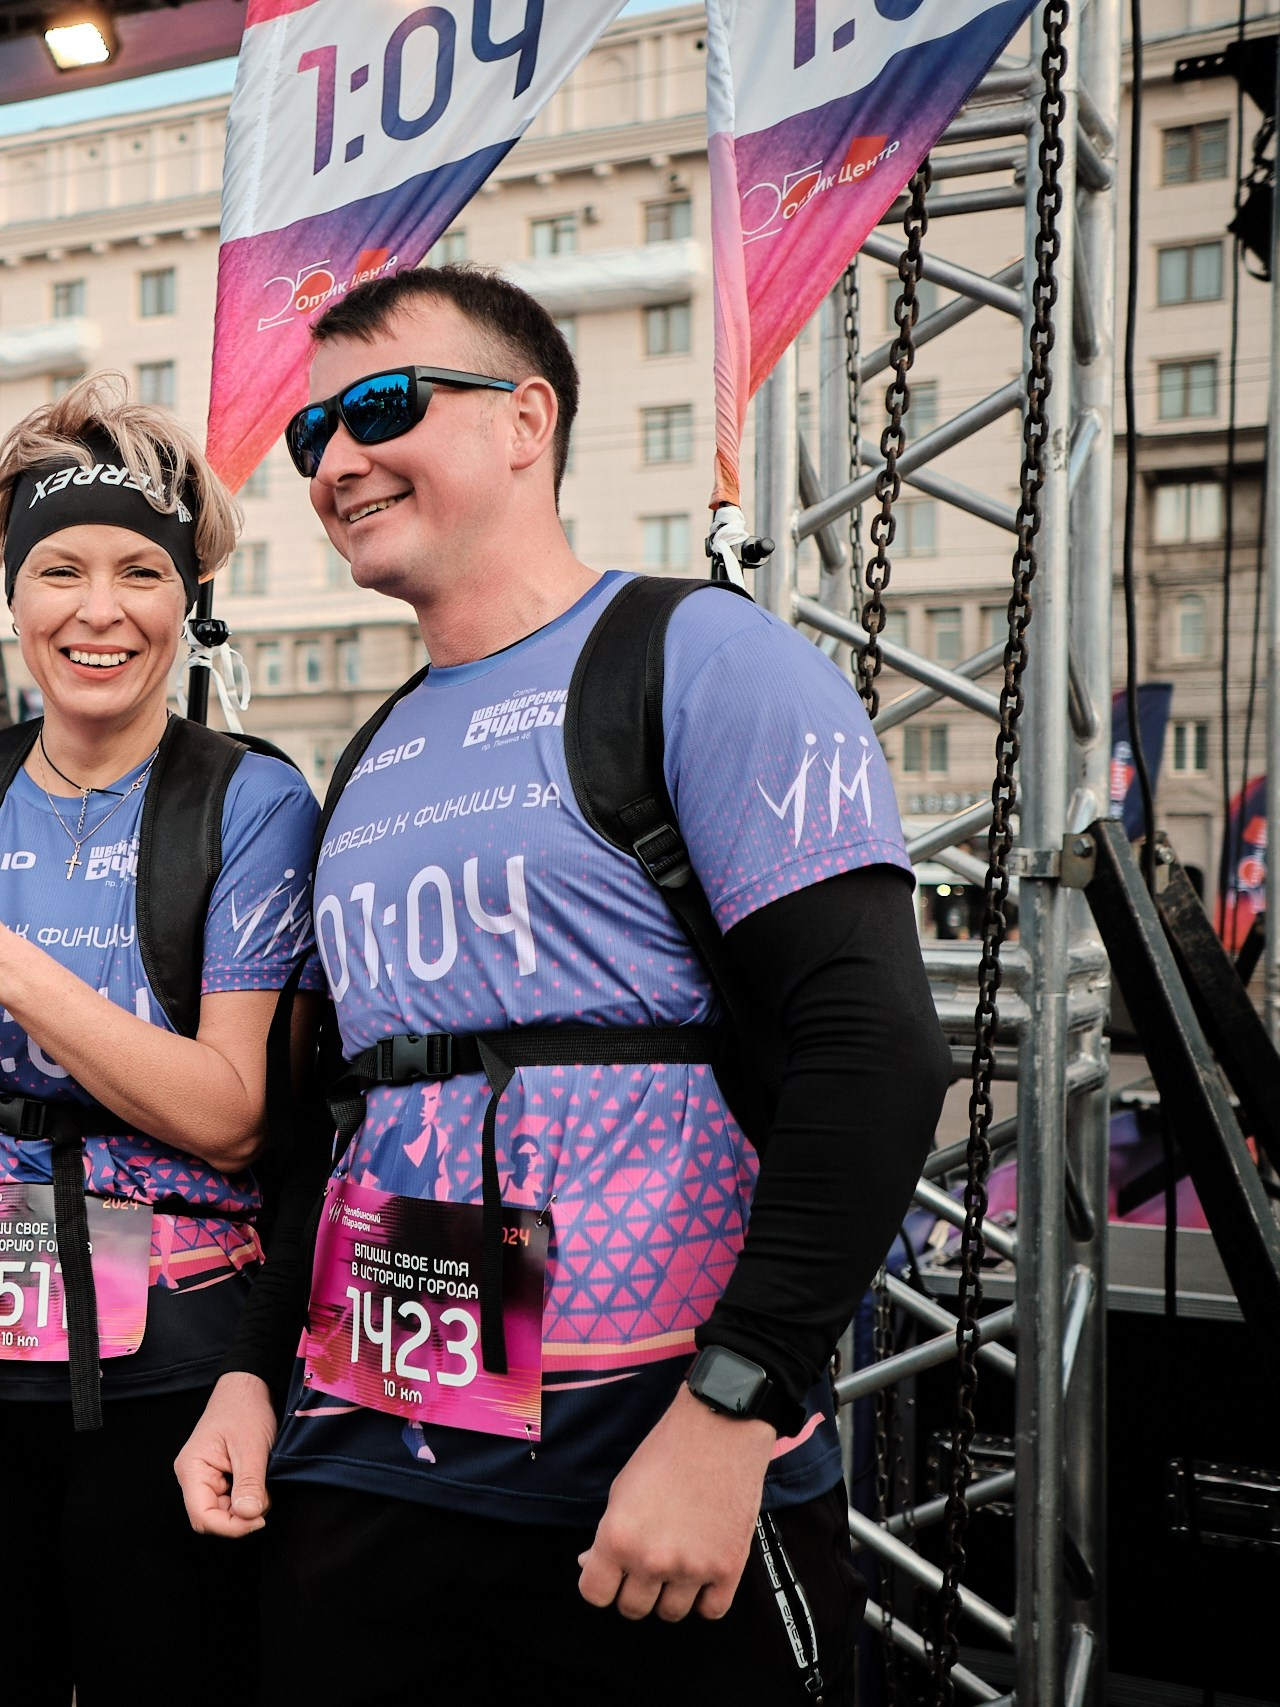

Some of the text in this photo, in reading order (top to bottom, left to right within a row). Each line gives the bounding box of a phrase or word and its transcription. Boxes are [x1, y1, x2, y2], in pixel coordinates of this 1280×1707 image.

[297, 0, 544, 176] 1:04
[838, 140, 900, 184] Центр
[296, 281, 348, 310] Оптик
[471, 689, 568, 723] ШВЕЙЦАРСКИ
[490, 703, 566, 738] ЧАСЫ
[392, 812, 410, 836] К
[414, 784, 516, 829] ФИНИШУ
[523, 782, 561, 810] ЗА
[316, 855, 537, 1003] 01:04
[16, 1222, 49, 1235] СВОЕ
[342, 1215, 370, 1232] Марафон
[344, 1205, 381, 1224] Челябинский
[355, 1242, 469, 1278] ВПИШИ СВОЕ ИМЯ
[351, 1262, 480, 1301] В ИСТОРИЮ ГОРОДА
[1, 1331, 38, 1347] 10 км
[346, 1285, 479, 1388] 1423
[383, 1379, 423, 1404] 10 км
